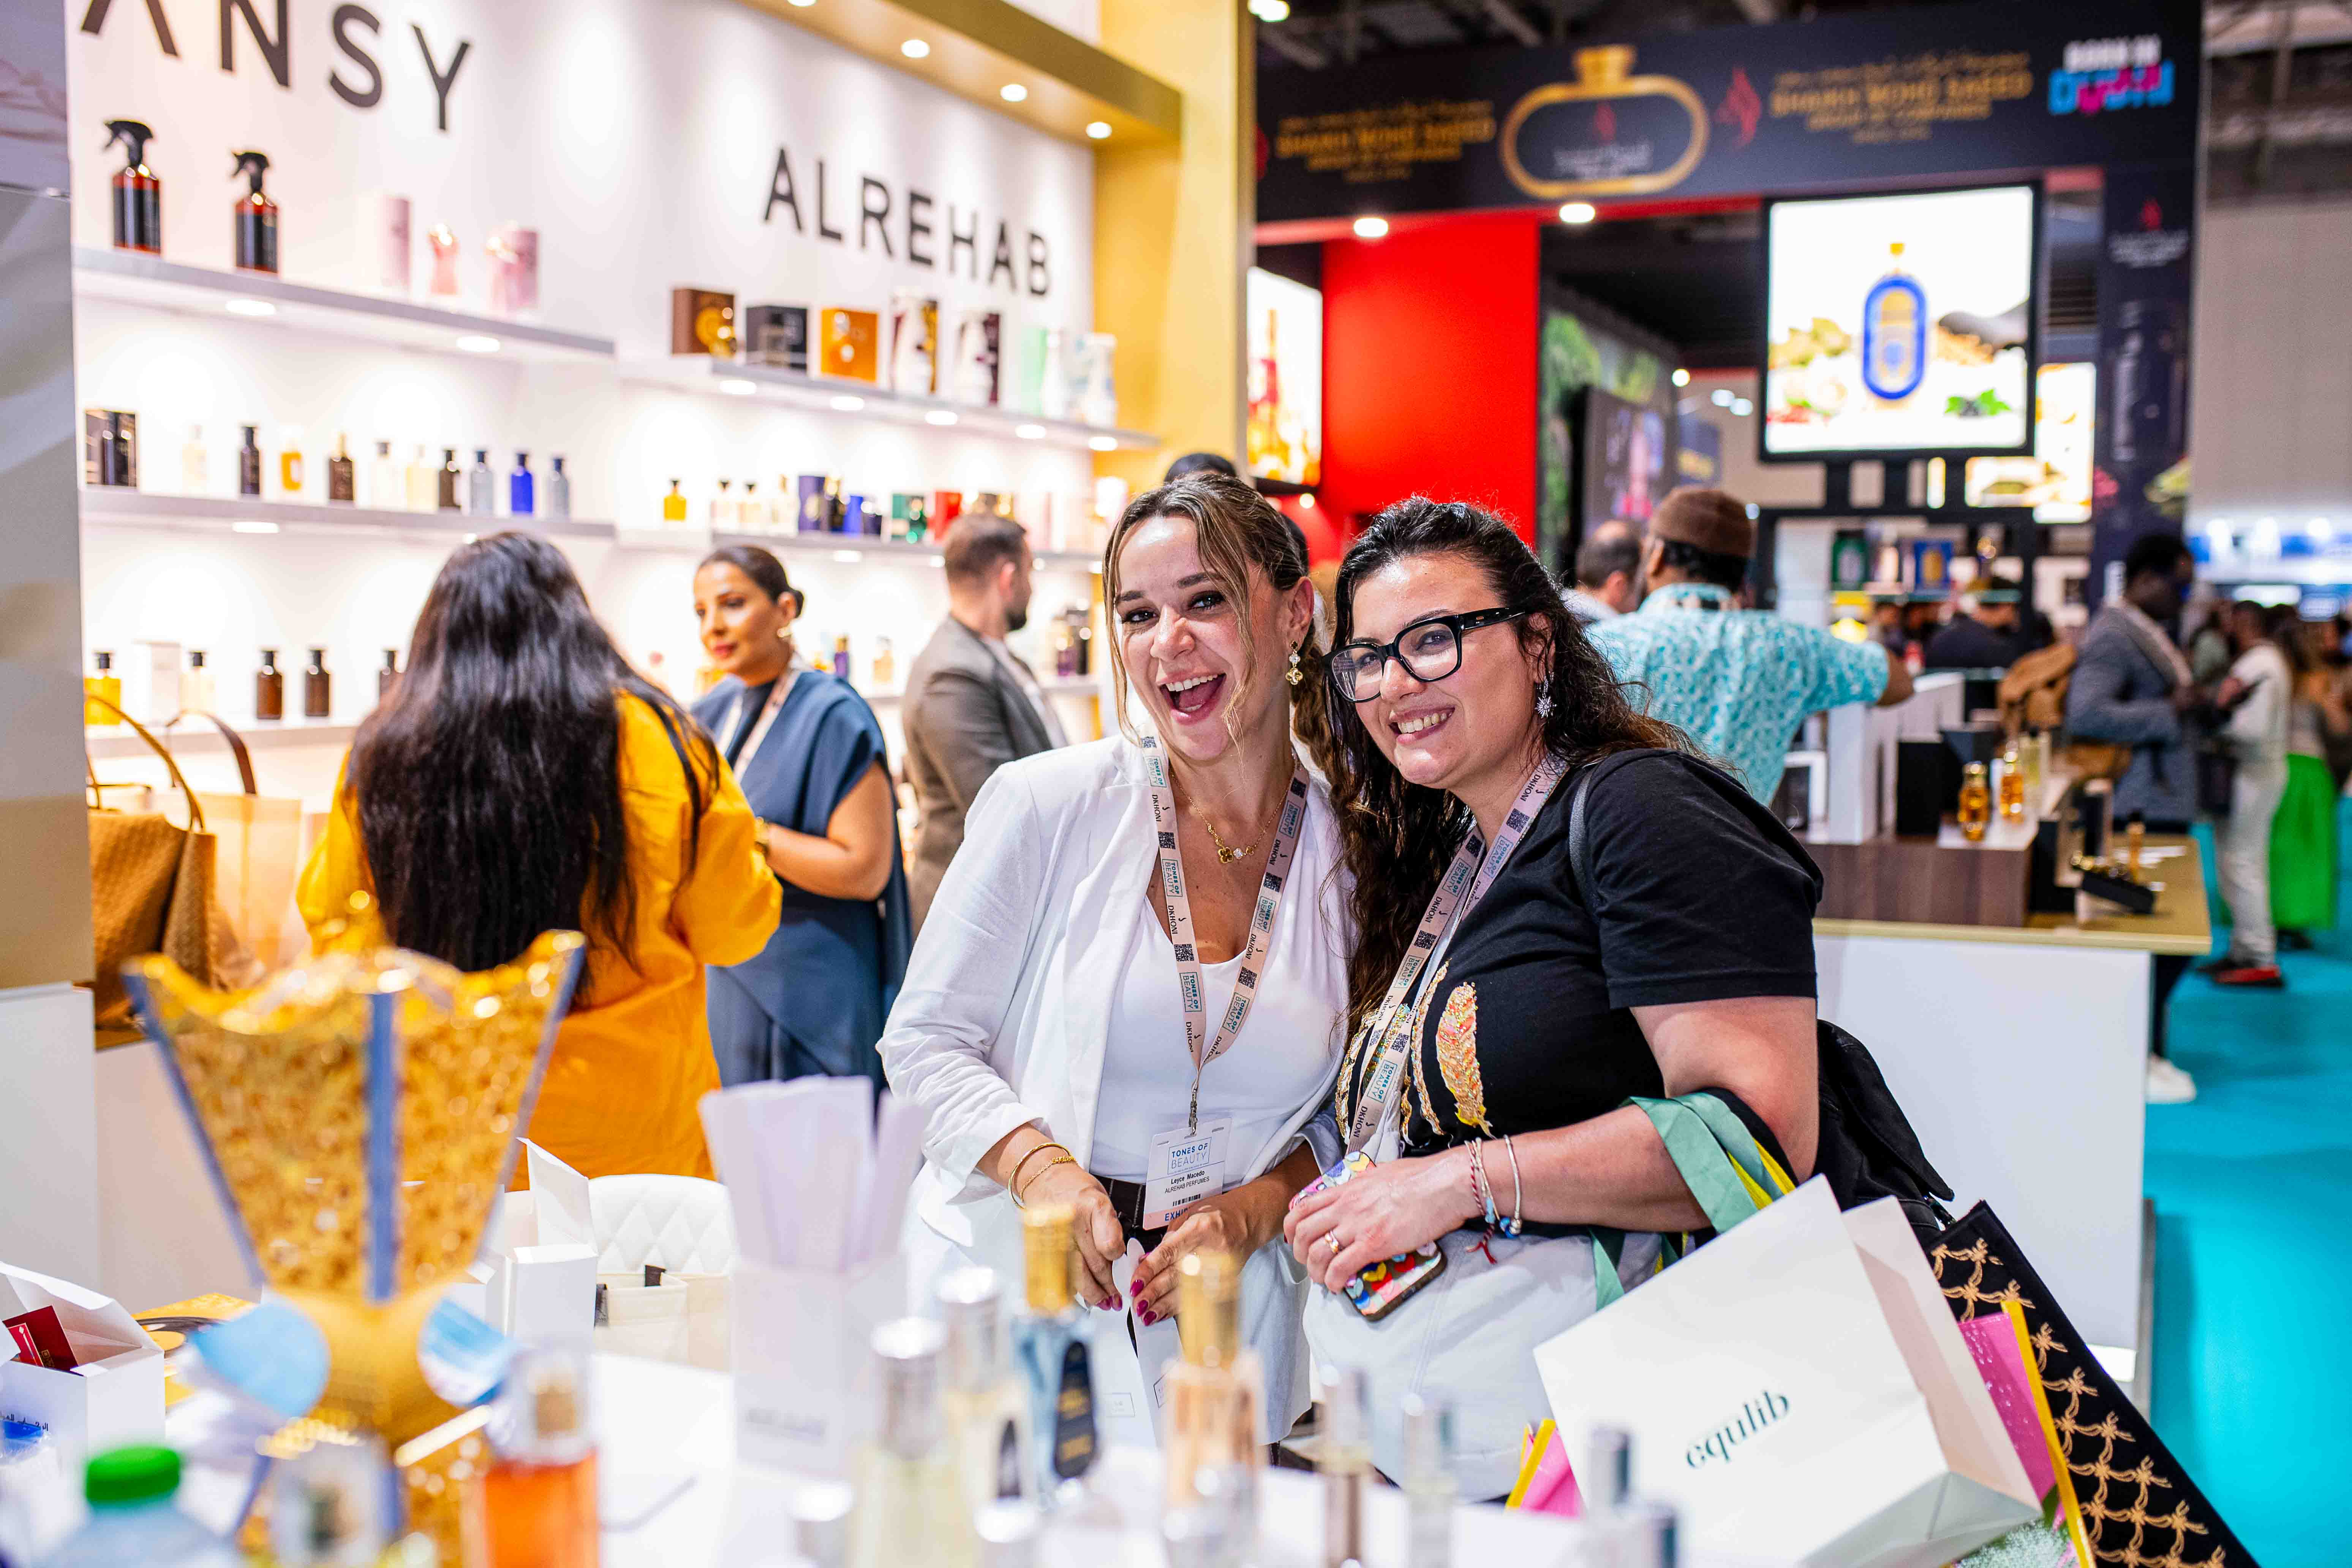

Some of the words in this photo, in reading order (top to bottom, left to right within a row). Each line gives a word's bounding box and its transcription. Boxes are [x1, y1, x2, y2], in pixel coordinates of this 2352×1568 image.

[763, 146, 1052, 298] ALREHAB
[1148, 758, 1159, 784] BEAUTY
[1520, 774, 1541, 801] DKHONI
[1152, 794, 1162, 822] DKHONI
[1269, 839, 1281, 865] DKHONI
[1165, 862, 1174, 894] BEAUTY
[1447, 862, 1464, 891] BEAUTY
[1456, 866, 1469, 884] TONES
[1174, 885, 1180, 894] OF
[1452, 885, 1459, 893] OF
[1168, 905, 1178, 934] DKHONI
[1257, 899, 1268, 928] BEAUTY
[1265, 902, 1273, 920] TONES
[1425, 896, 1443, 923] DKHONI
[1263, 921, 1268, 929] OF
[1246, 933, 1257, 960] DKHONI
[1398, 958, 1415, 986] BEAUTY
[1407, 959, 1420, 977] TONES
[1183, 975, 1193, 1009] BEAUTY
[1193, 999, 1198, 1009] OF
[1227, 996, 1242, 1028] BEAUTY
[1236, 999, 1246, 1020] TONES
[1378, 995, 1394, 1021] DKHONI
[1231, 1021, 1237, 1031] OF
[1371, 1063, 1390, 1097] BEAUTY
[1382, 1065, 1394, 1088] TONES
[1377, 1089, 1384, 1100] OF
[1353, 1106, 1367, 1138] DKHONI
[1171, 1146, 1195, 1159] TONES
[1198, 1143, 1208, 1151] OF
[1171, 1151, 1207, 1169] BEAUTY
[1165, 1184, 1185, 1194] ALREHAB
[1186, 1176, 1210, 1188] PERFUMES
[1171, 1176, 1185, 1185] Leyce
[1187, 1170, 1205, 1179] Macedo
[1165, 1207, 1189, 1222] EXHI
